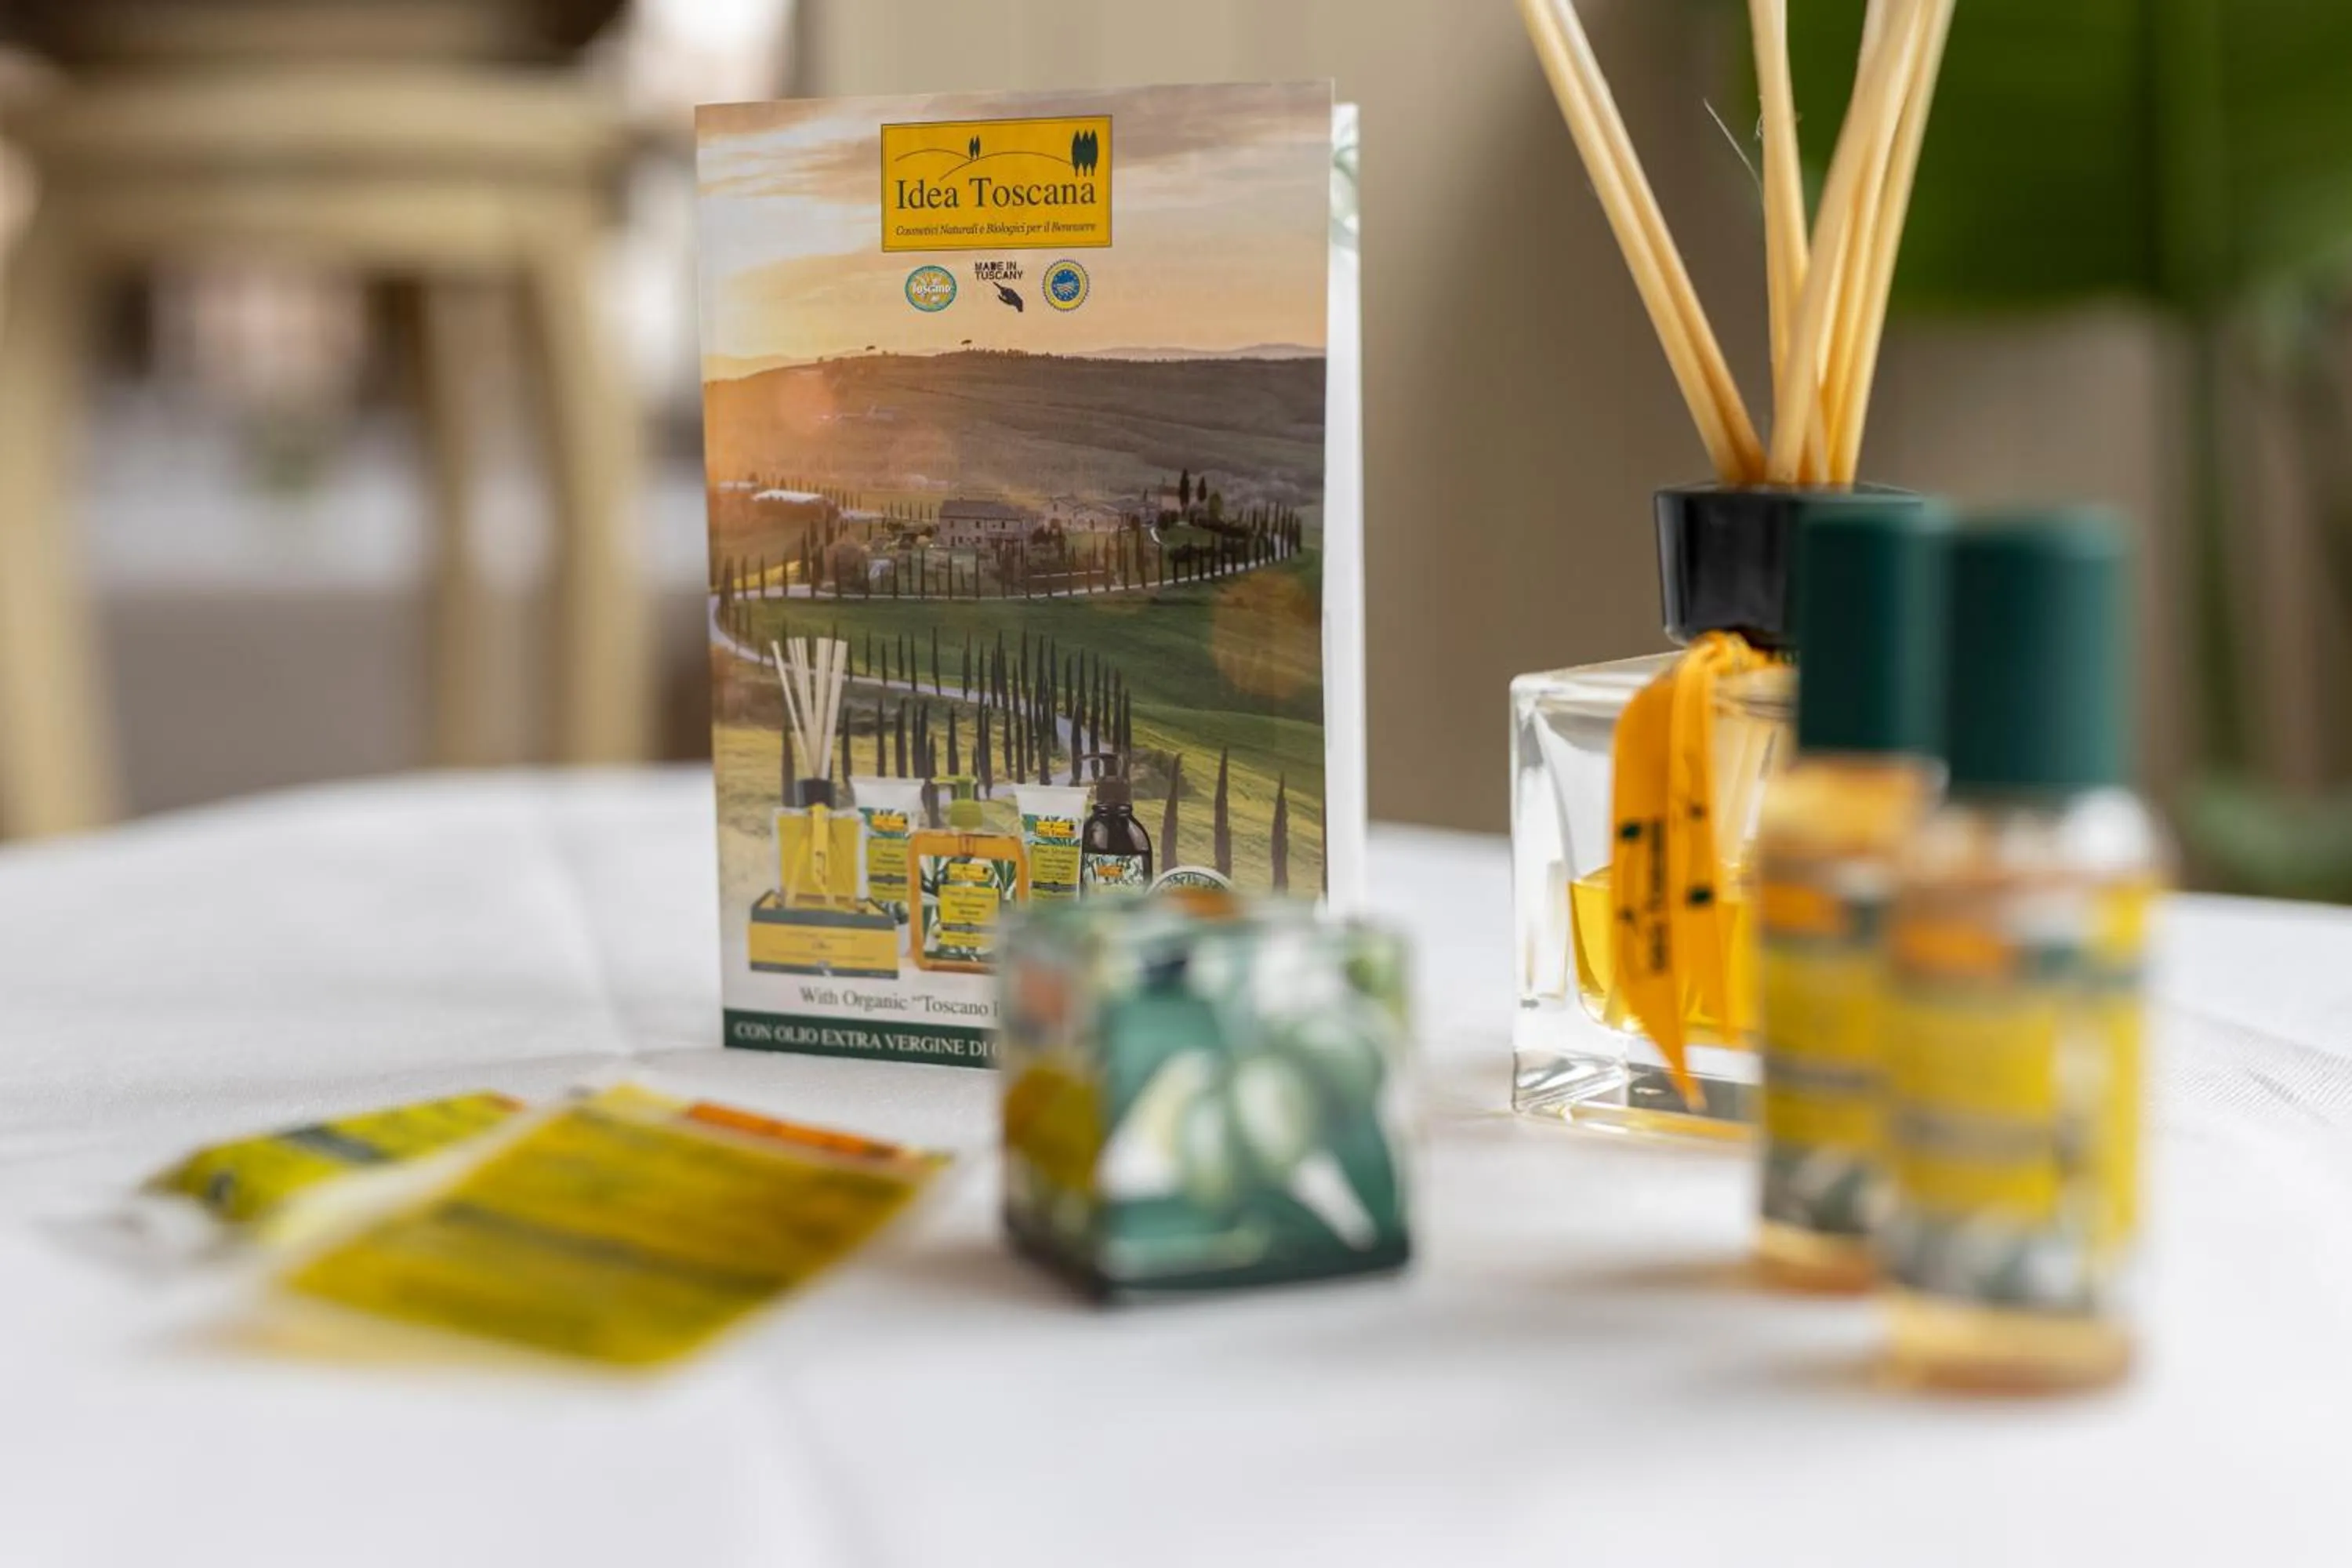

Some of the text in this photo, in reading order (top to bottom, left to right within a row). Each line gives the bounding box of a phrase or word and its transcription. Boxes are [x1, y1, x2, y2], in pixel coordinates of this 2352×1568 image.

[895, 176, 1097, 209] Idea Toscana
[1025, 224, 1041, 236] per
[1044, 221, 1050, 233] il
[975, 260, 1017, 271] MADE IN
[975, 270, 1023, 281] TUSCANY
[799, 986, 839, 1004] With
[843, 989, 908, 1012] Organic
[734, 1021, 771, 1040] CON
[774, 1025, 819, 1045] OLIO
[821, 1028, 882, 1049] EXTRA
[884, 1033, 966, 1056] VERGINE
[968, 1040, 988, 1057] DI
